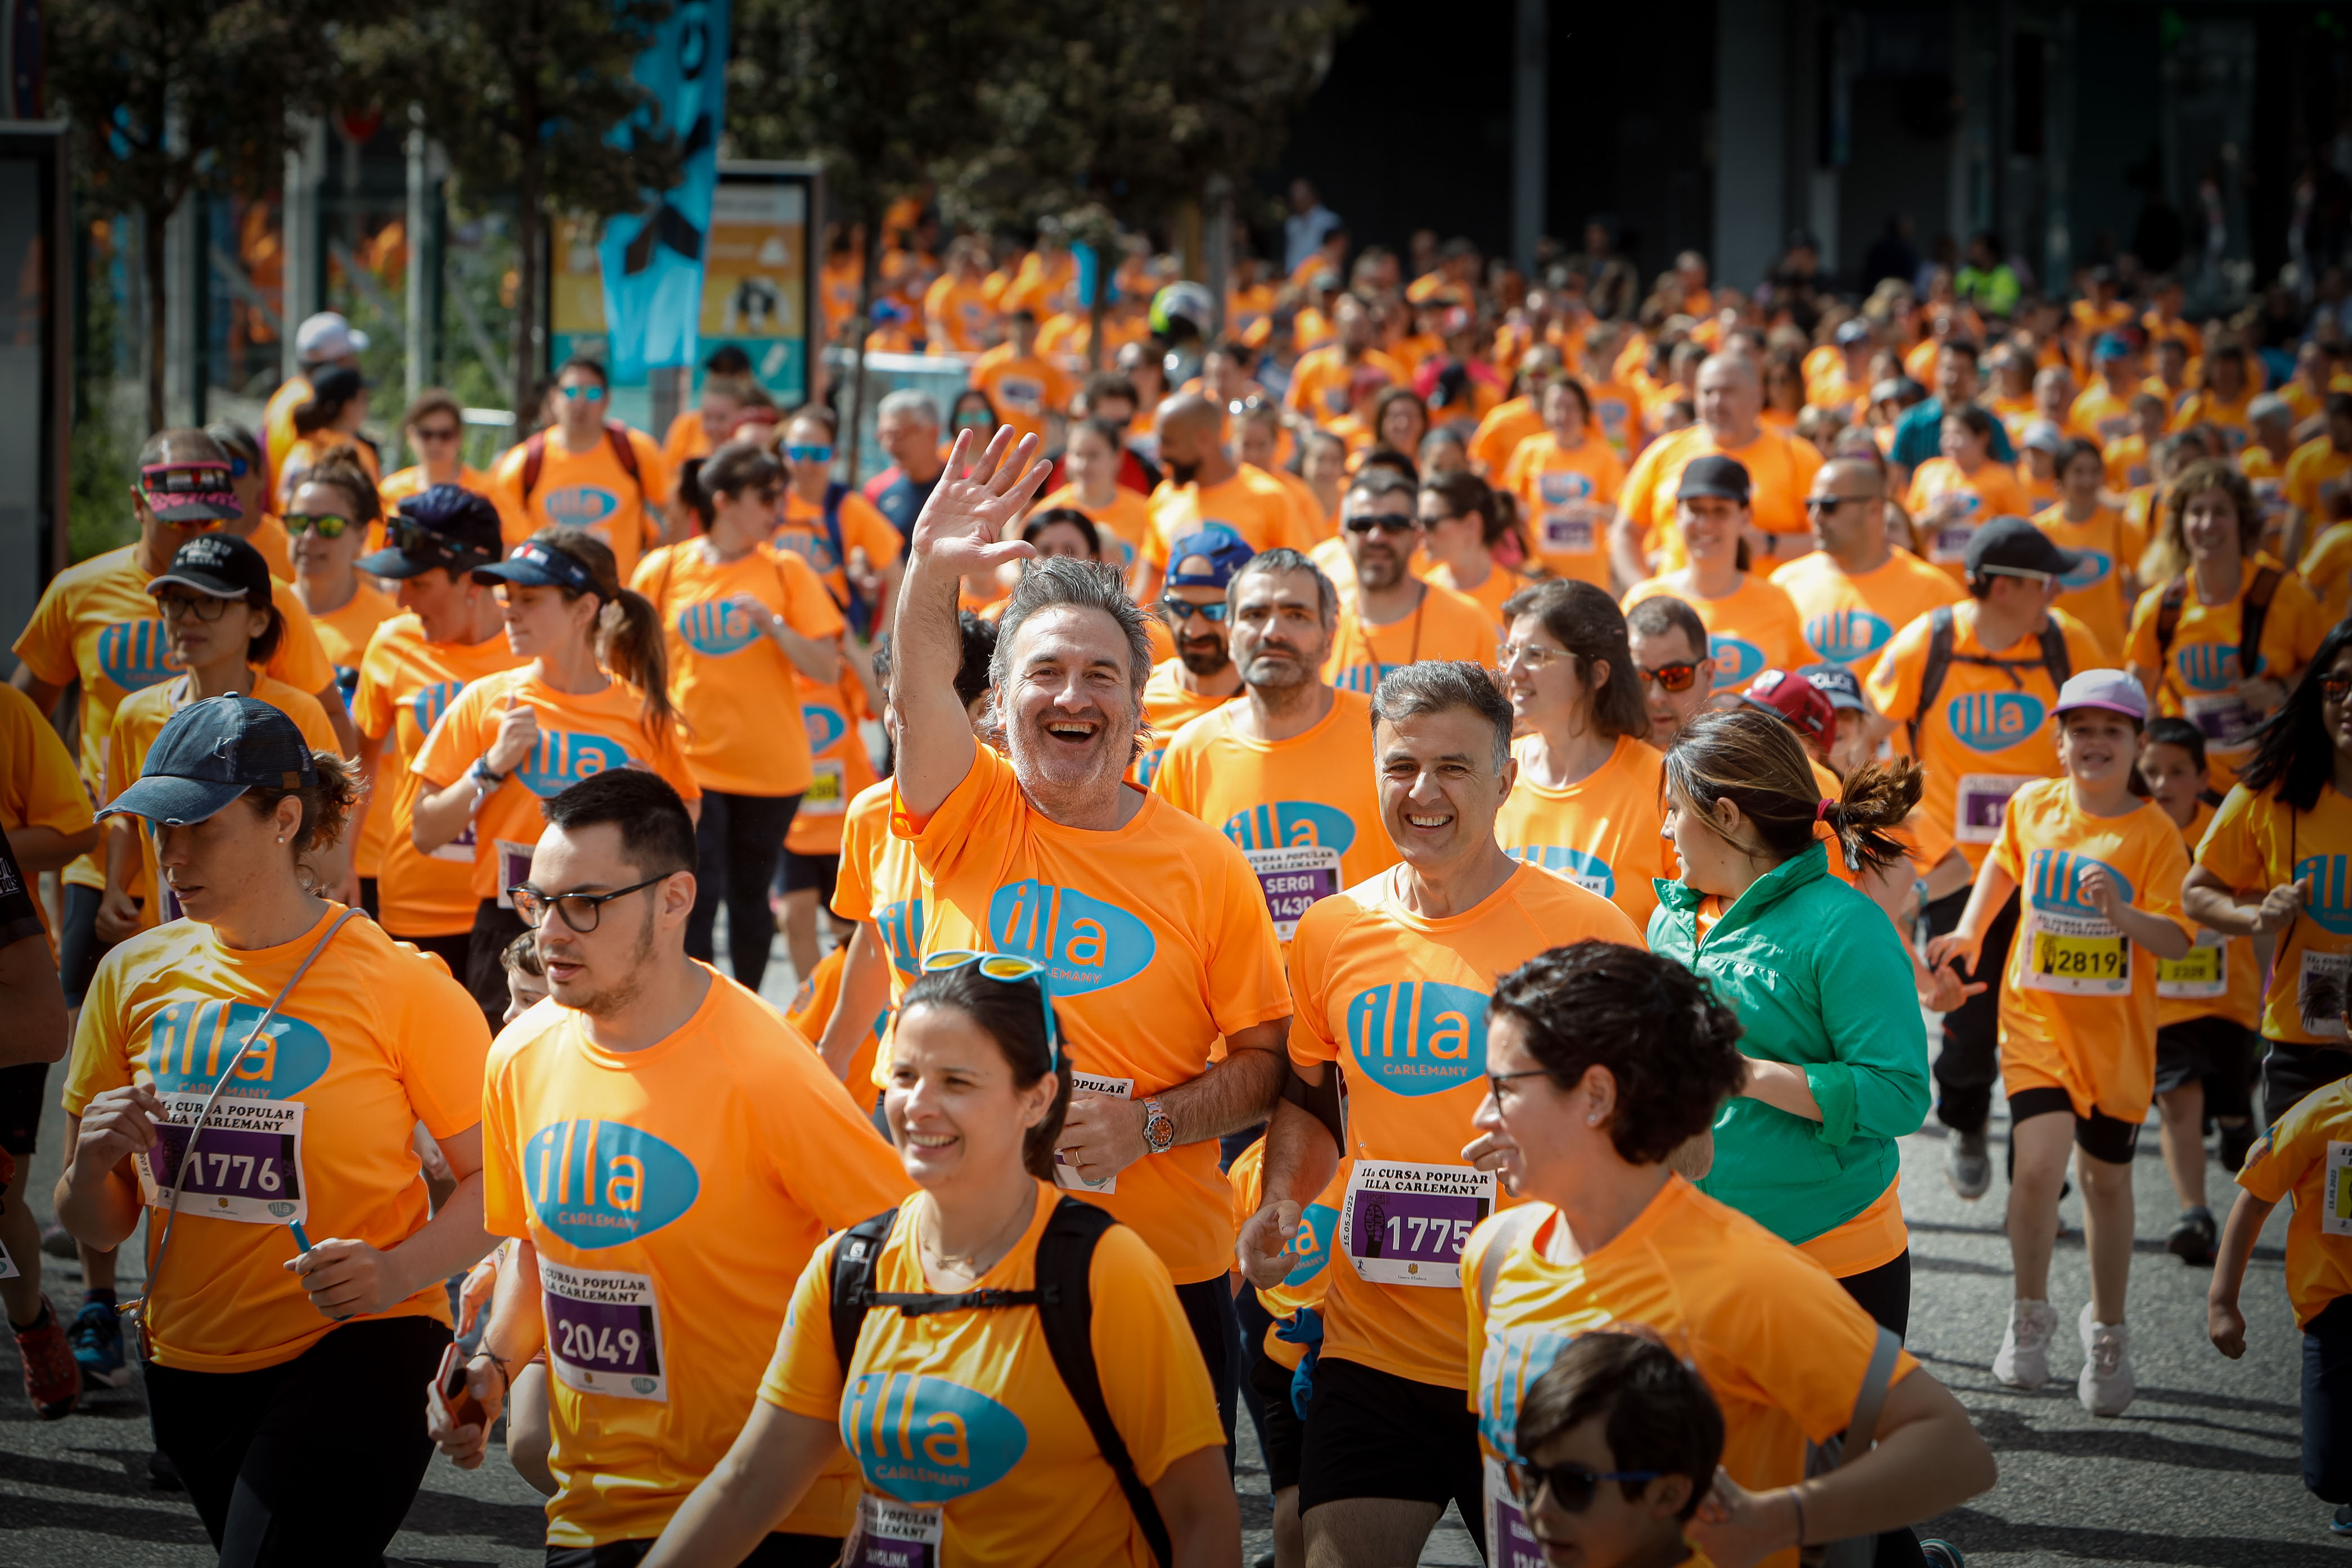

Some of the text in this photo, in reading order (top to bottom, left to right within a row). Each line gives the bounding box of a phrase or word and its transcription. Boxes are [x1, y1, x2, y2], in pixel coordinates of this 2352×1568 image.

[685, 600, 750, 638] illa
[1958, 693, 2024, 734] illa
[1266, 875, 1315, 894] SERGI
[1003, 884, 1107, 968] illa
[2058, 950, 2118, 974] 2819
[1361, 980, 1470, 1060] illa
[160, 1001, 278, 1082] illa
[1072, 1078, 1126, 1094] OPULAR
[1383, 1064, 1468, 1077] CARLEMANY
[176, 1102, 222, 1114] CURA
[227, 1106, 294, 1120] POPULAR
[187, 1151, 281, 1192] 1776
[539, 1118, 644, 1213] illa
[1361, 1168, 1488, 1185] 11a CURSA POPULAR
[1364, 1180, 1479, 1195] ILLA CARLEMANY
[558, 1211, 639, 1232] CARLEMANY
[1344, 1195, 1353, 1248] 15.05.2022
[1387, 1215, 1473, 1255] 1775
[559, 1284, 639, 1303] CARLEMANY
[583, 1275, 647, 1291] POPULAR
[558, 1319, 640, 1365] 2049
[850, 1372, 970, 1469] illa
[875, 1465, 970, 1488] CARLEMANY
